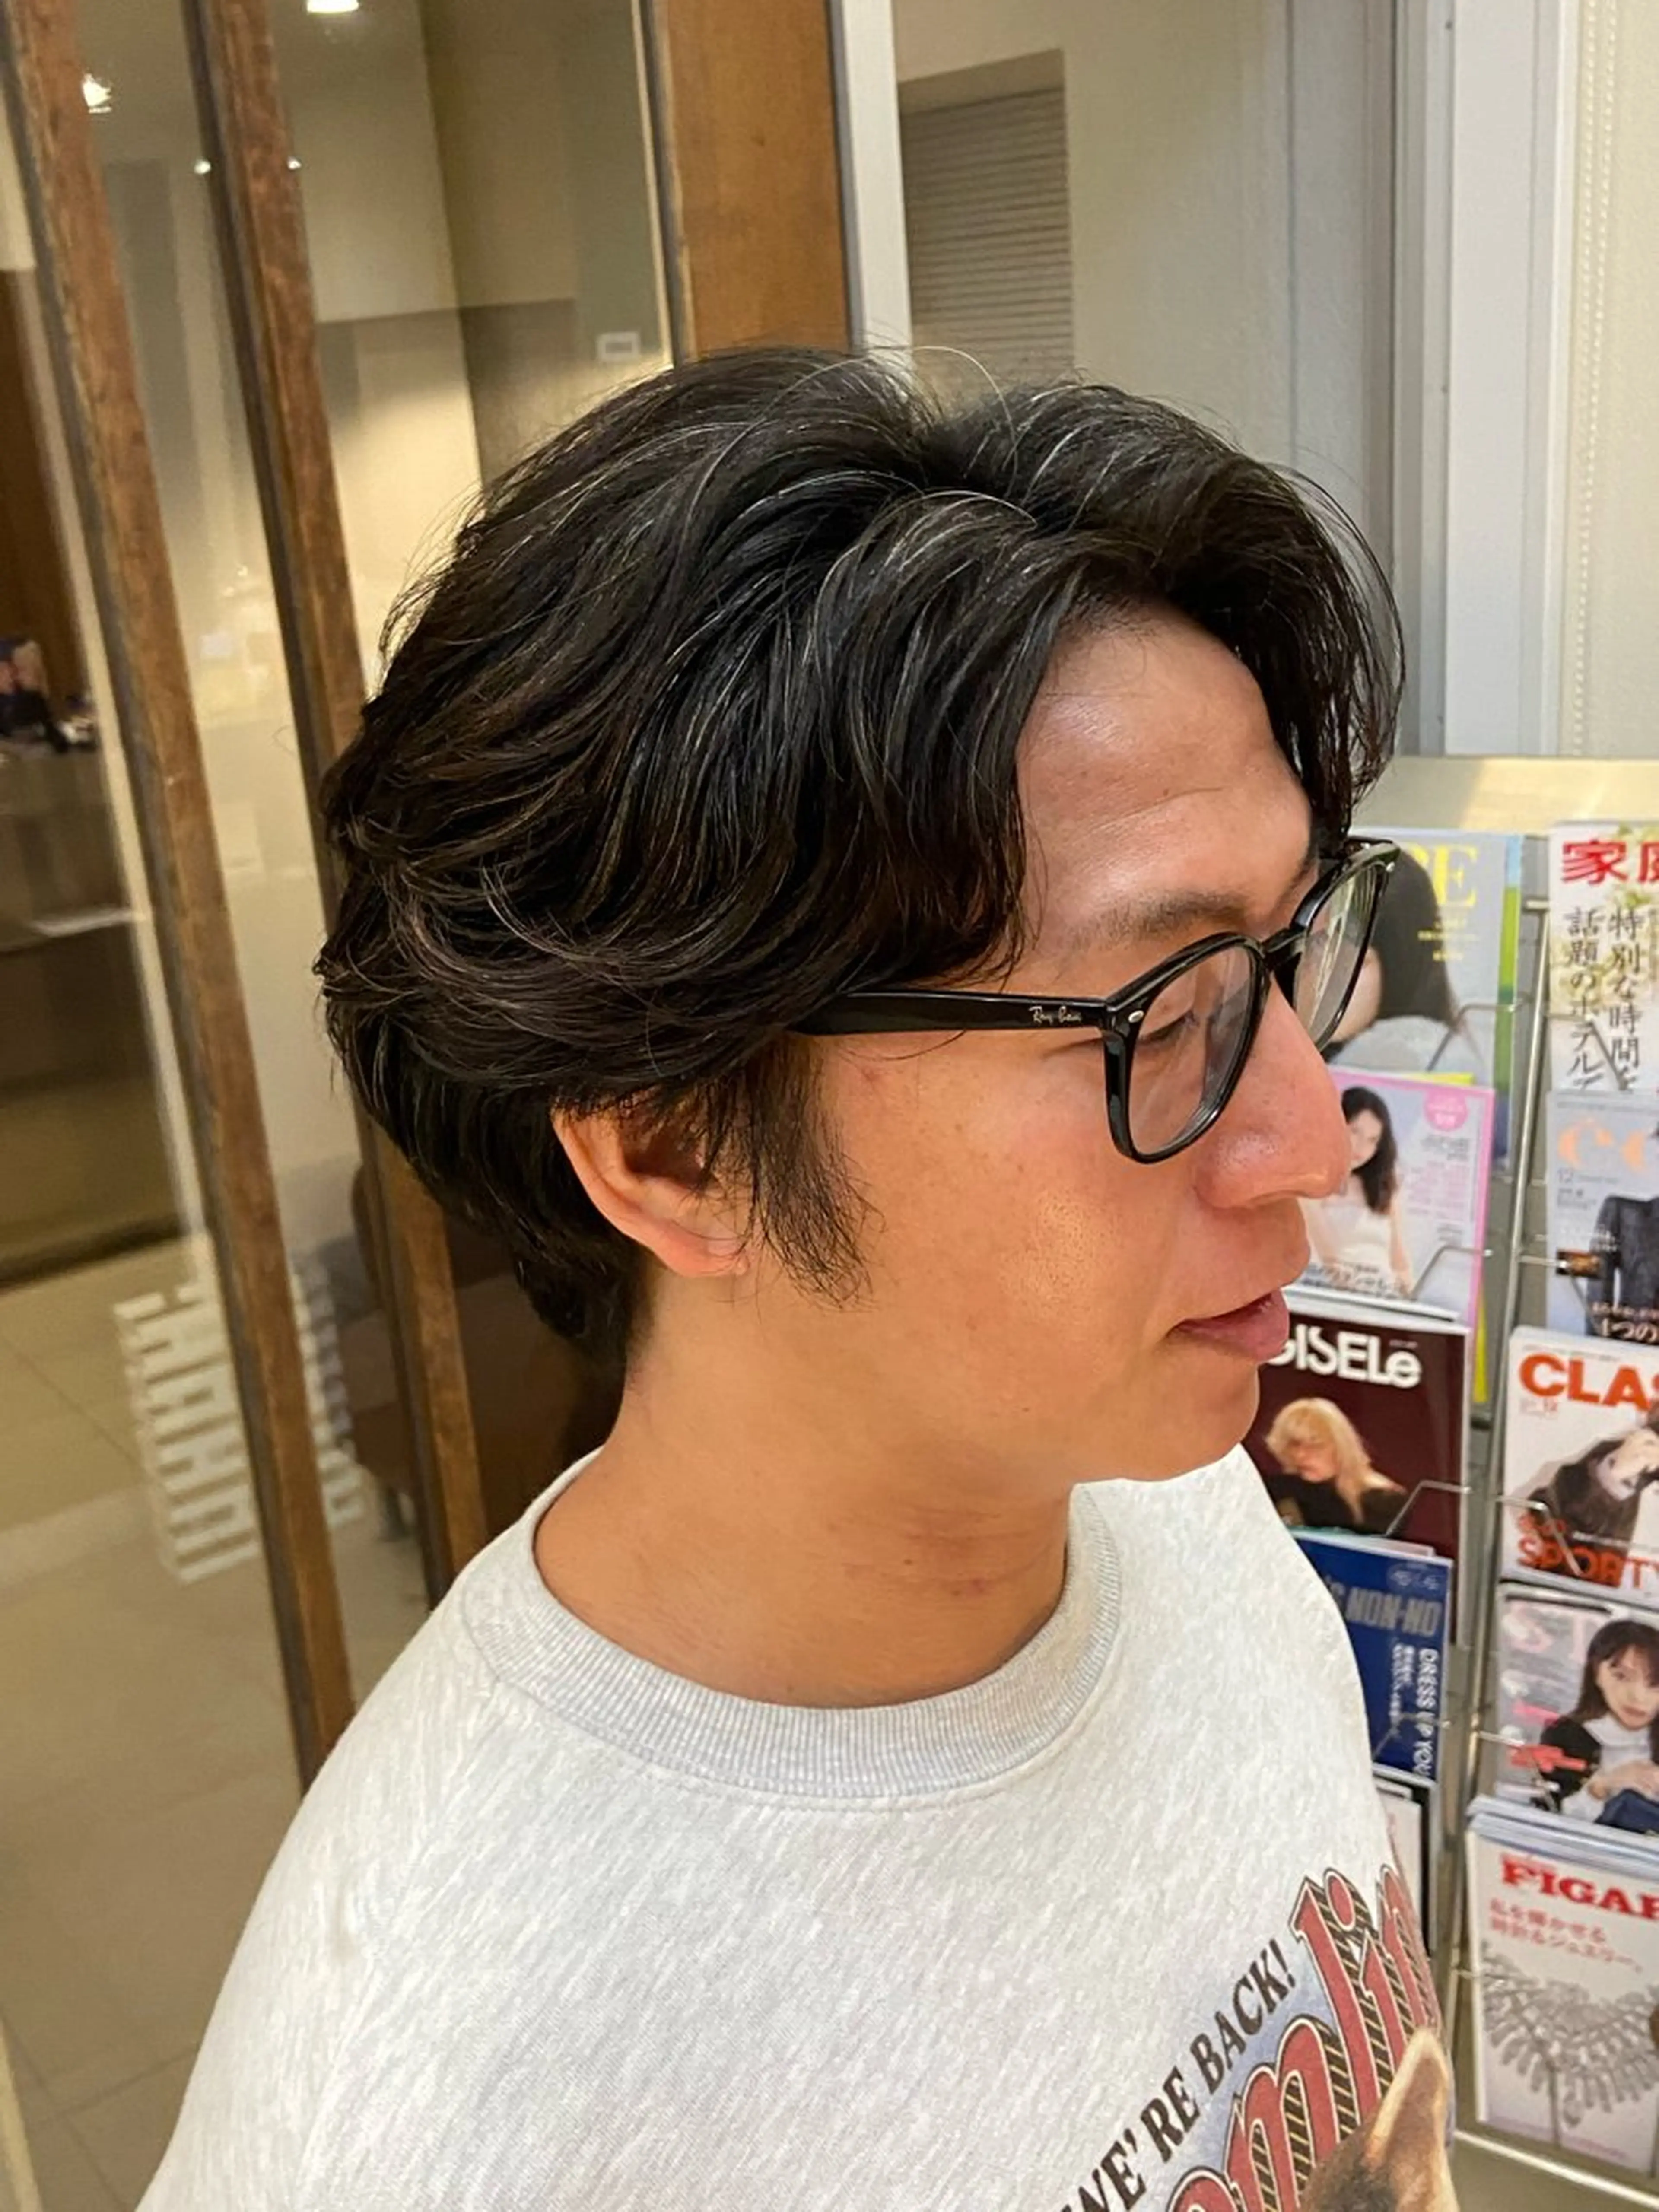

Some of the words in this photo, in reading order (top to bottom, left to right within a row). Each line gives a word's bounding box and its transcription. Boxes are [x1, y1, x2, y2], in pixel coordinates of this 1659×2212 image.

[1519, 1352, 1659, 1412] CLA
[1517, 1535, 1659, 1589] SPORT
[1189, 1938, 1296, 2095] BACK!
